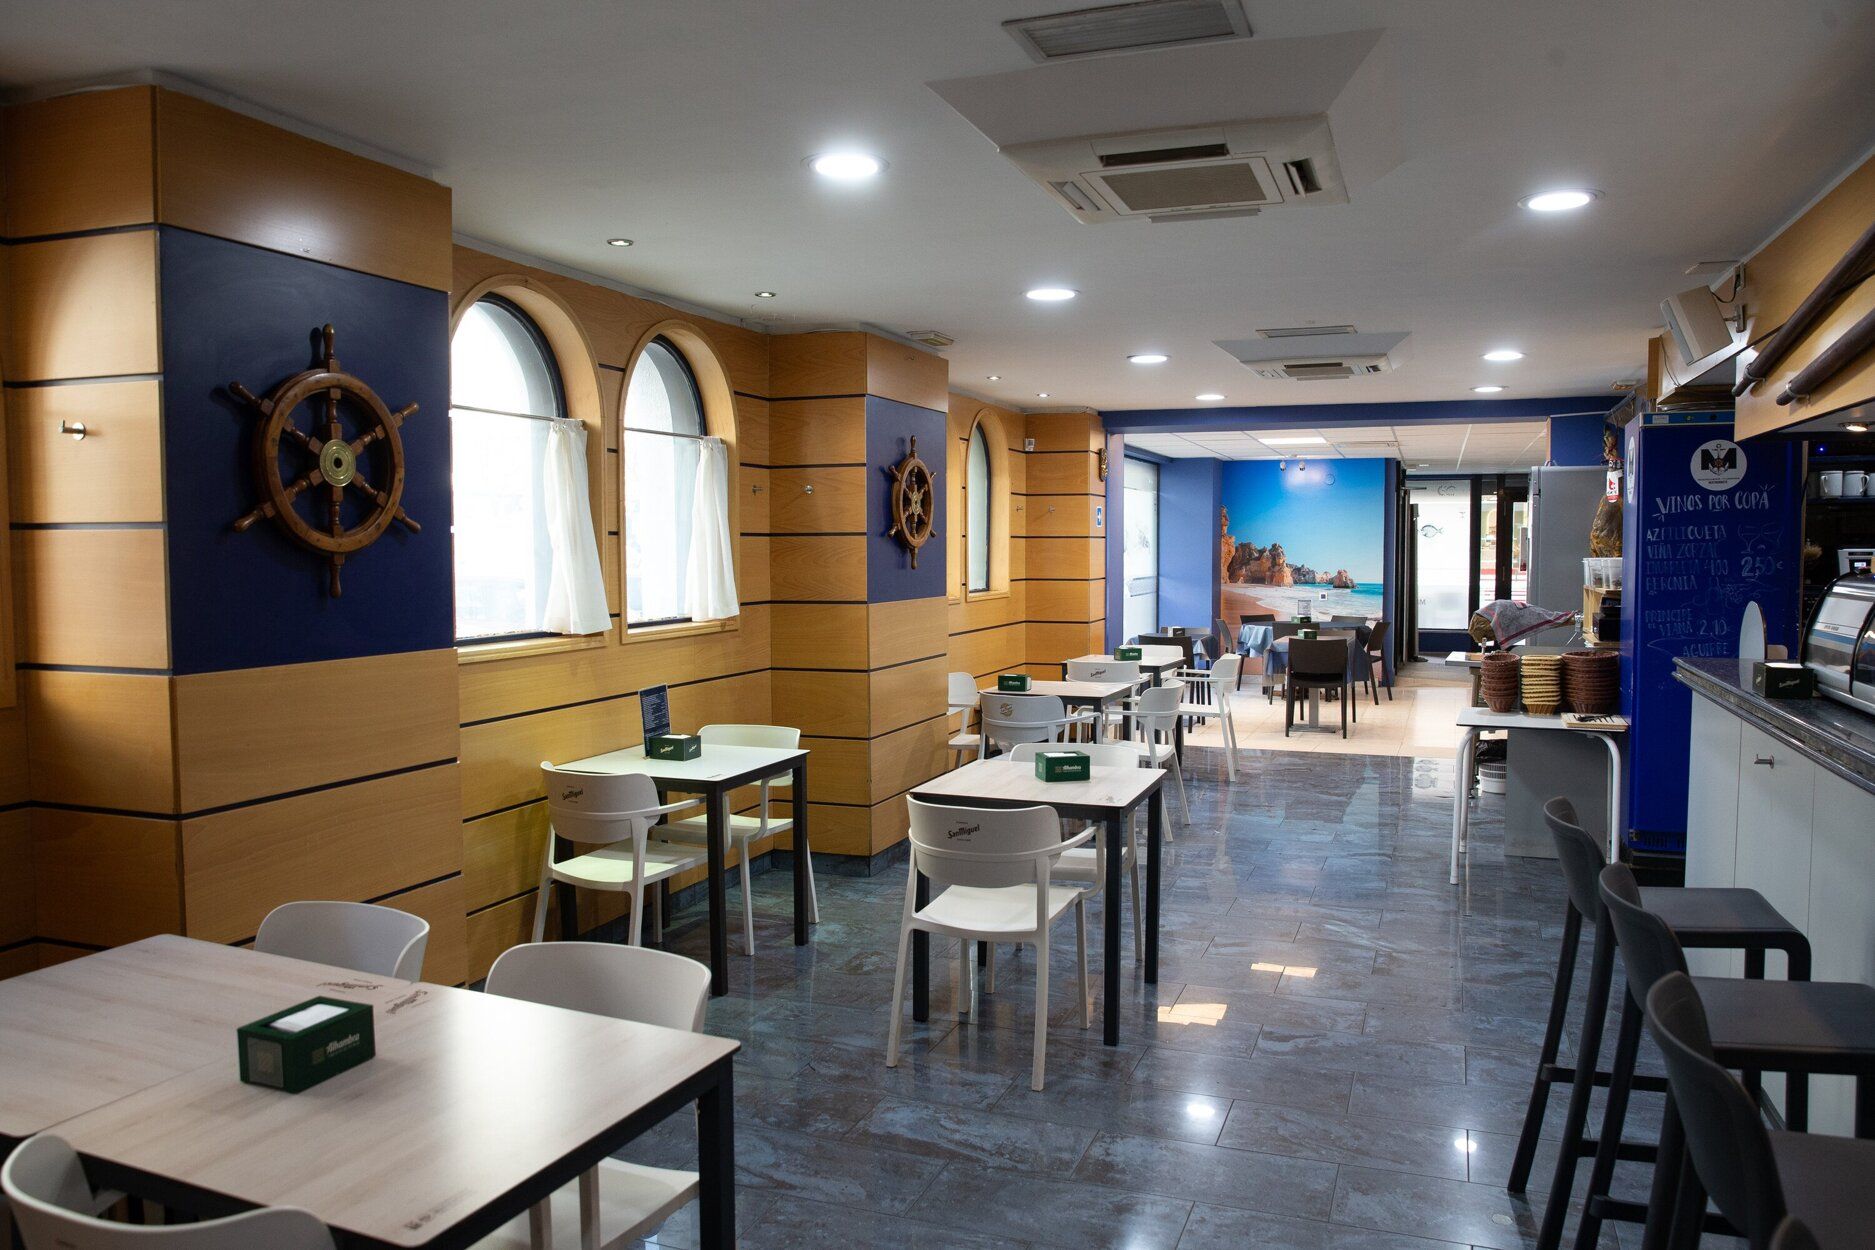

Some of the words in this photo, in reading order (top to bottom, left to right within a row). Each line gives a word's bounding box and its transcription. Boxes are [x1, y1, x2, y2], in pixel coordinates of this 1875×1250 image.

[1655, 494, 1703, 514] VINOS
[1708, 494, 1730, 511] POR
[1734, 491, 1769, 510] COPA
